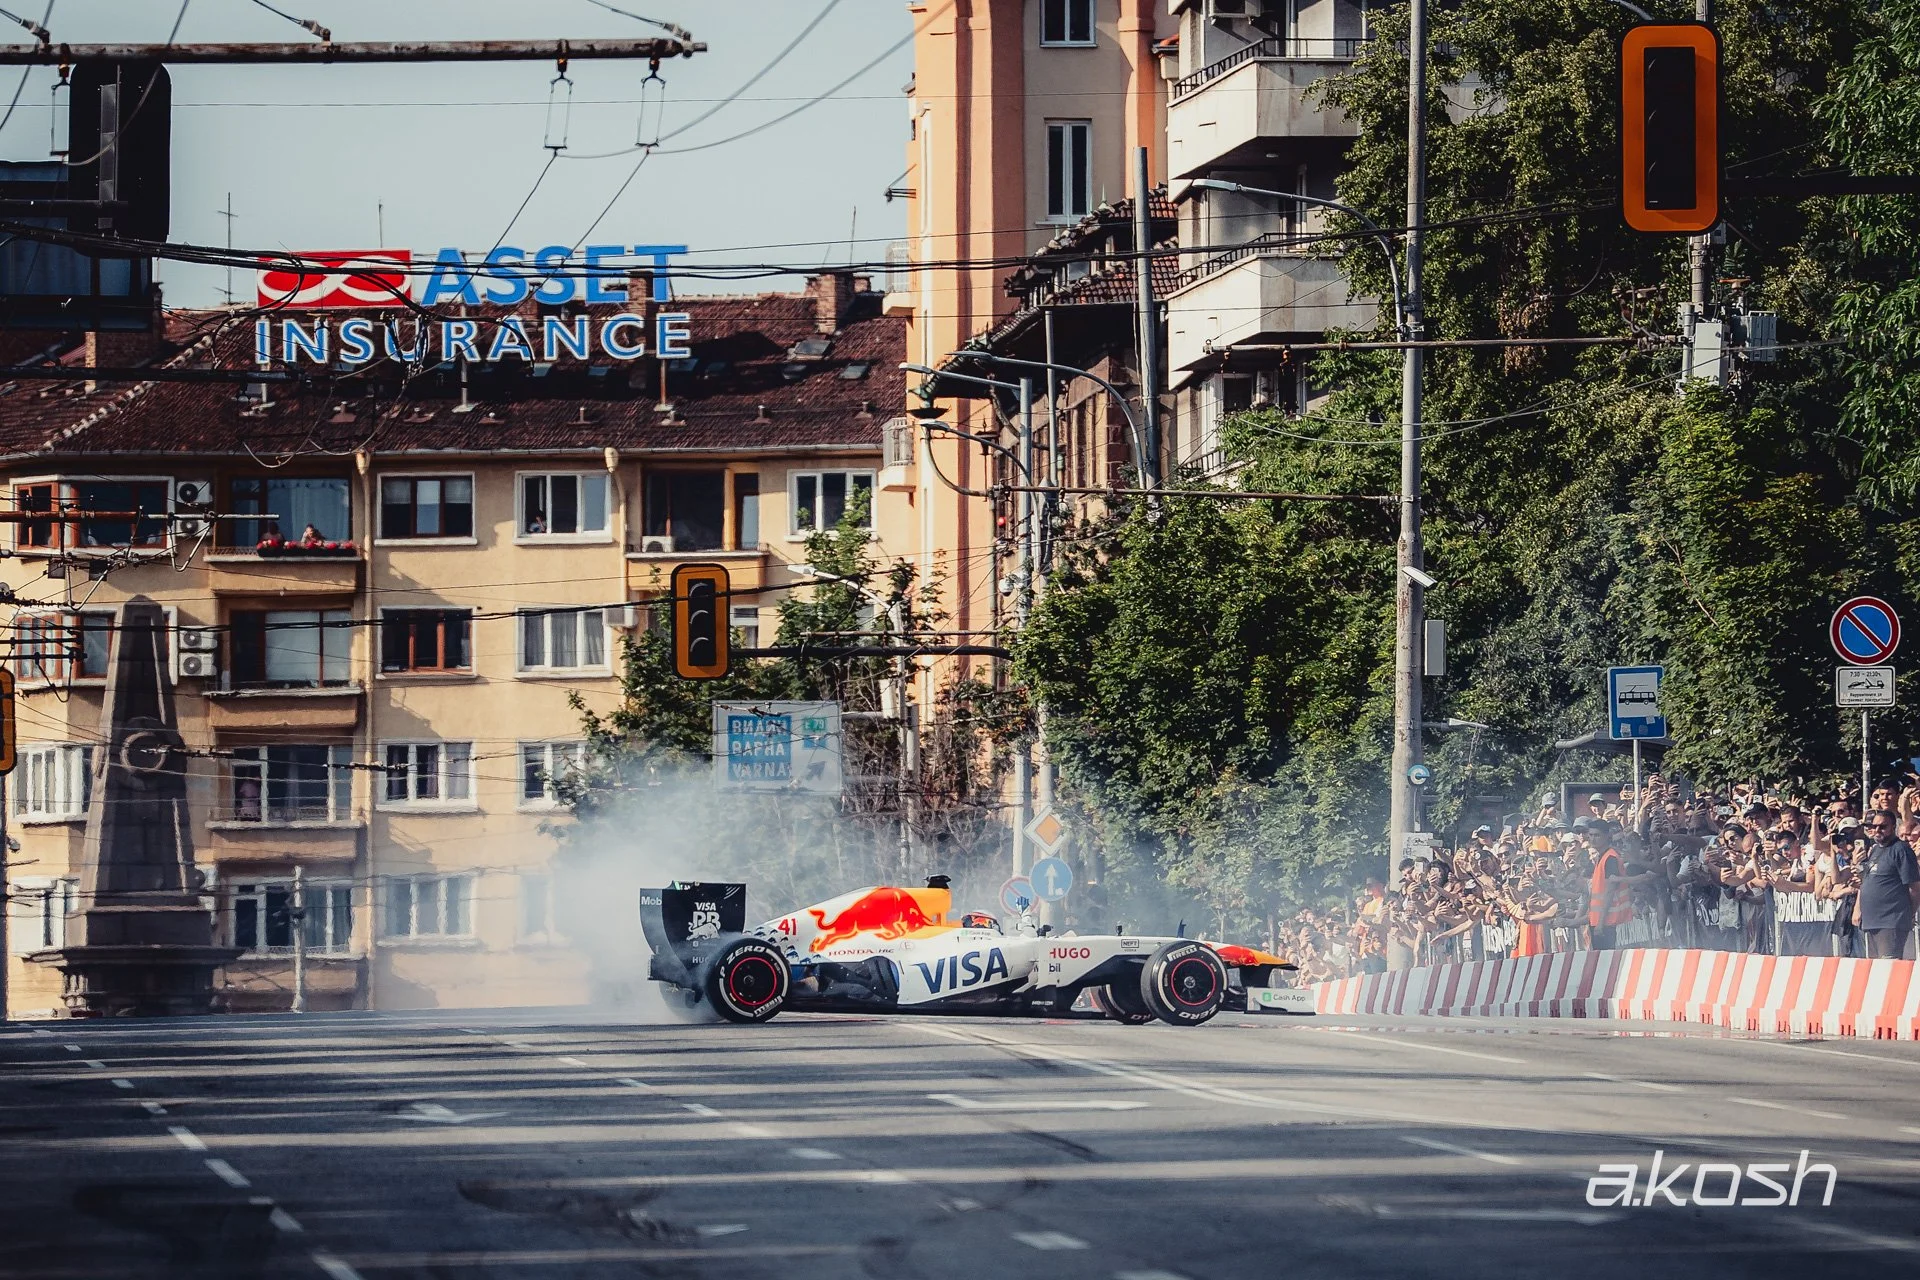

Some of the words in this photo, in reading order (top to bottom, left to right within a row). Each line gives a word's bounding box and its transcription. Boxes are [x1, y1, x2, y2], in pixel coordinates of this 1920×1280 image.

[422, 245, 688, 305] ASSET
[255, 312, 691, 363] INSURANCE
[732, 741, 785, 756] ВАРНА
[732, 762, 786, 778] VARNA
[694, 902, 716, 911] VISA
[778, 918, 797, 935] 41
[727, 945, 765, 965] ZERO
[828, 948, 874, 957] HONDA
[910, 947, 1008, 994] VISA
[1178, 1004, 1217, 1020] ZERO
